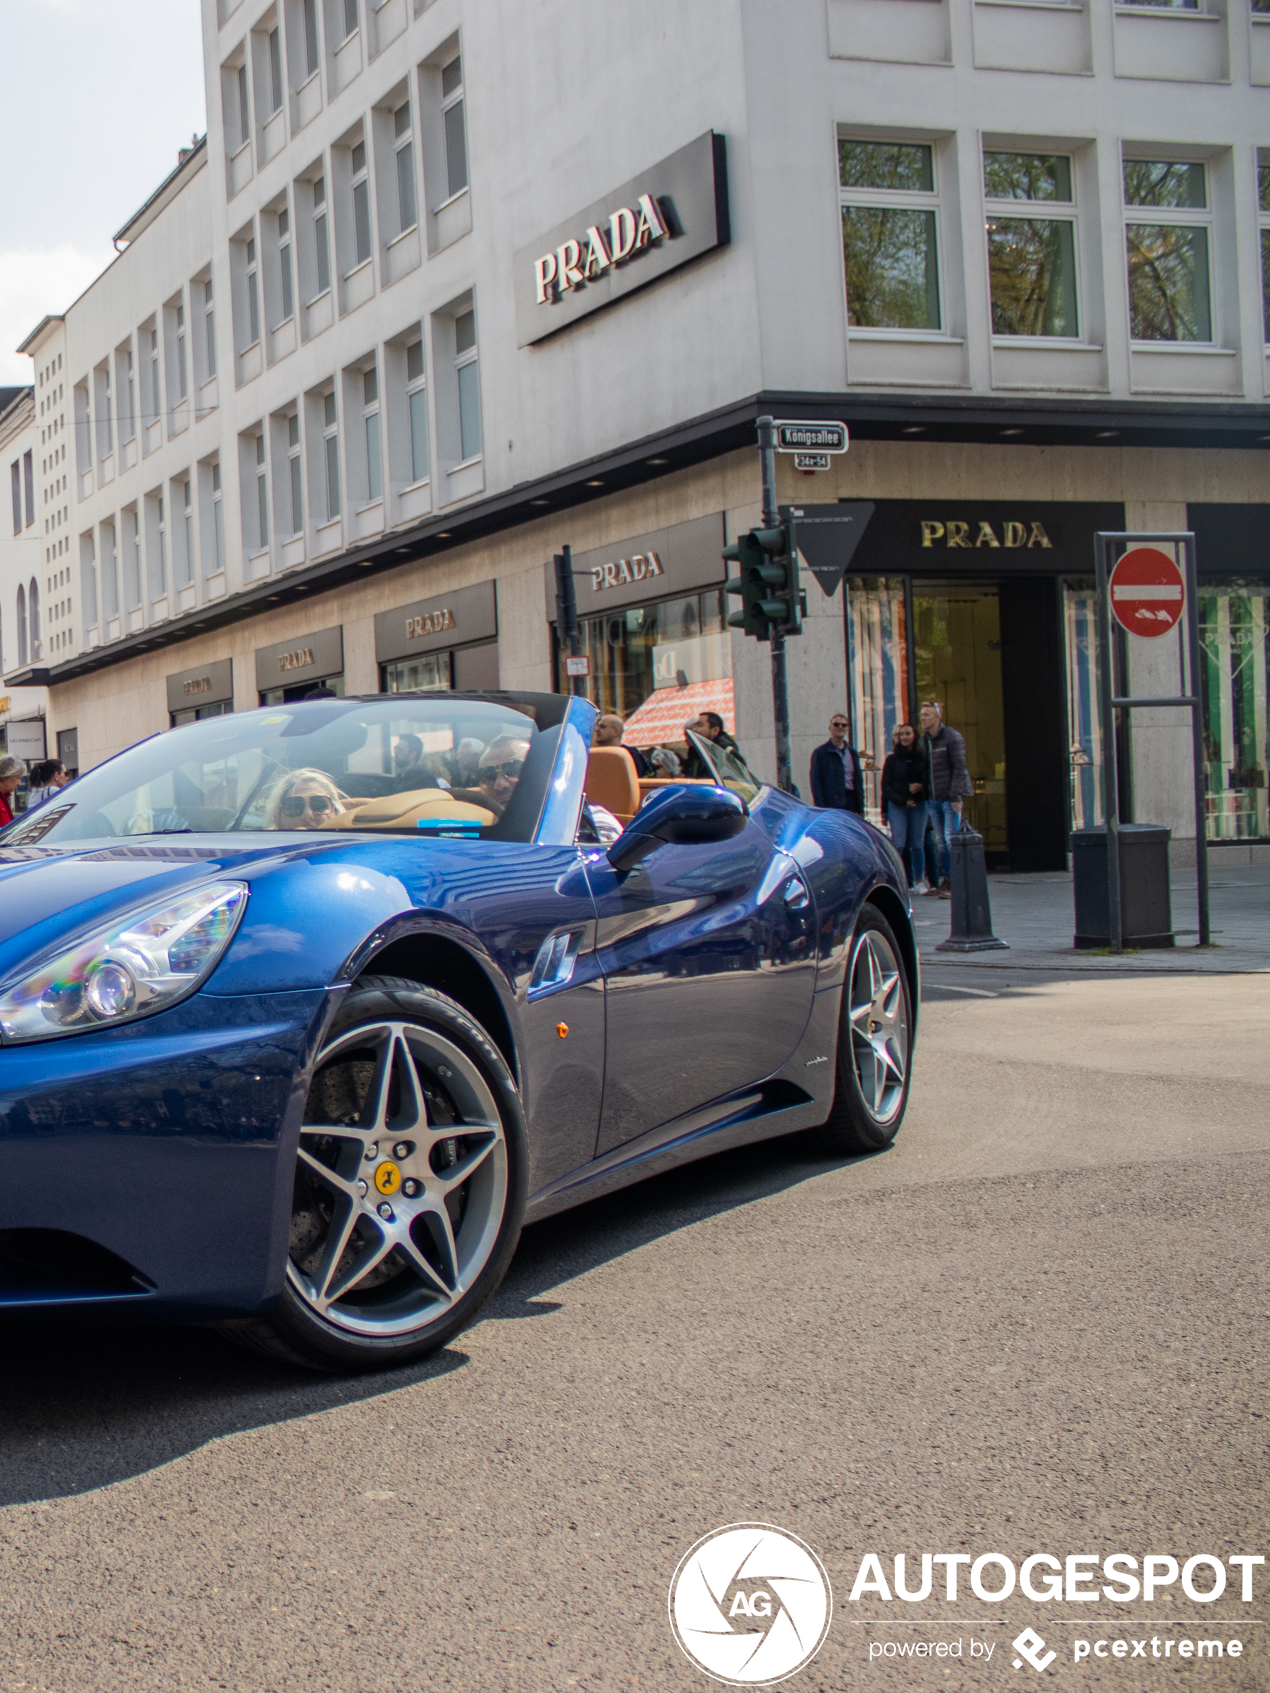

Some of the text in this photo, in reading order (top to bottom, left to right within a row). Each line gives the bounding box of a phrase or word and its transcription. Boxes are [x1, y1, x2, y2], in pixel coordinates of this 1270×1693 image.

[534, 193, 670, 305] PRADA
[785, 428, 839, 446] Königsallee
[921, 521, 1053, 548] PRADA
[591, 552, 664, 591] PRADA
[405, 608, 456, 639] PRADA
[278, 648, 314, 672] PRADA
